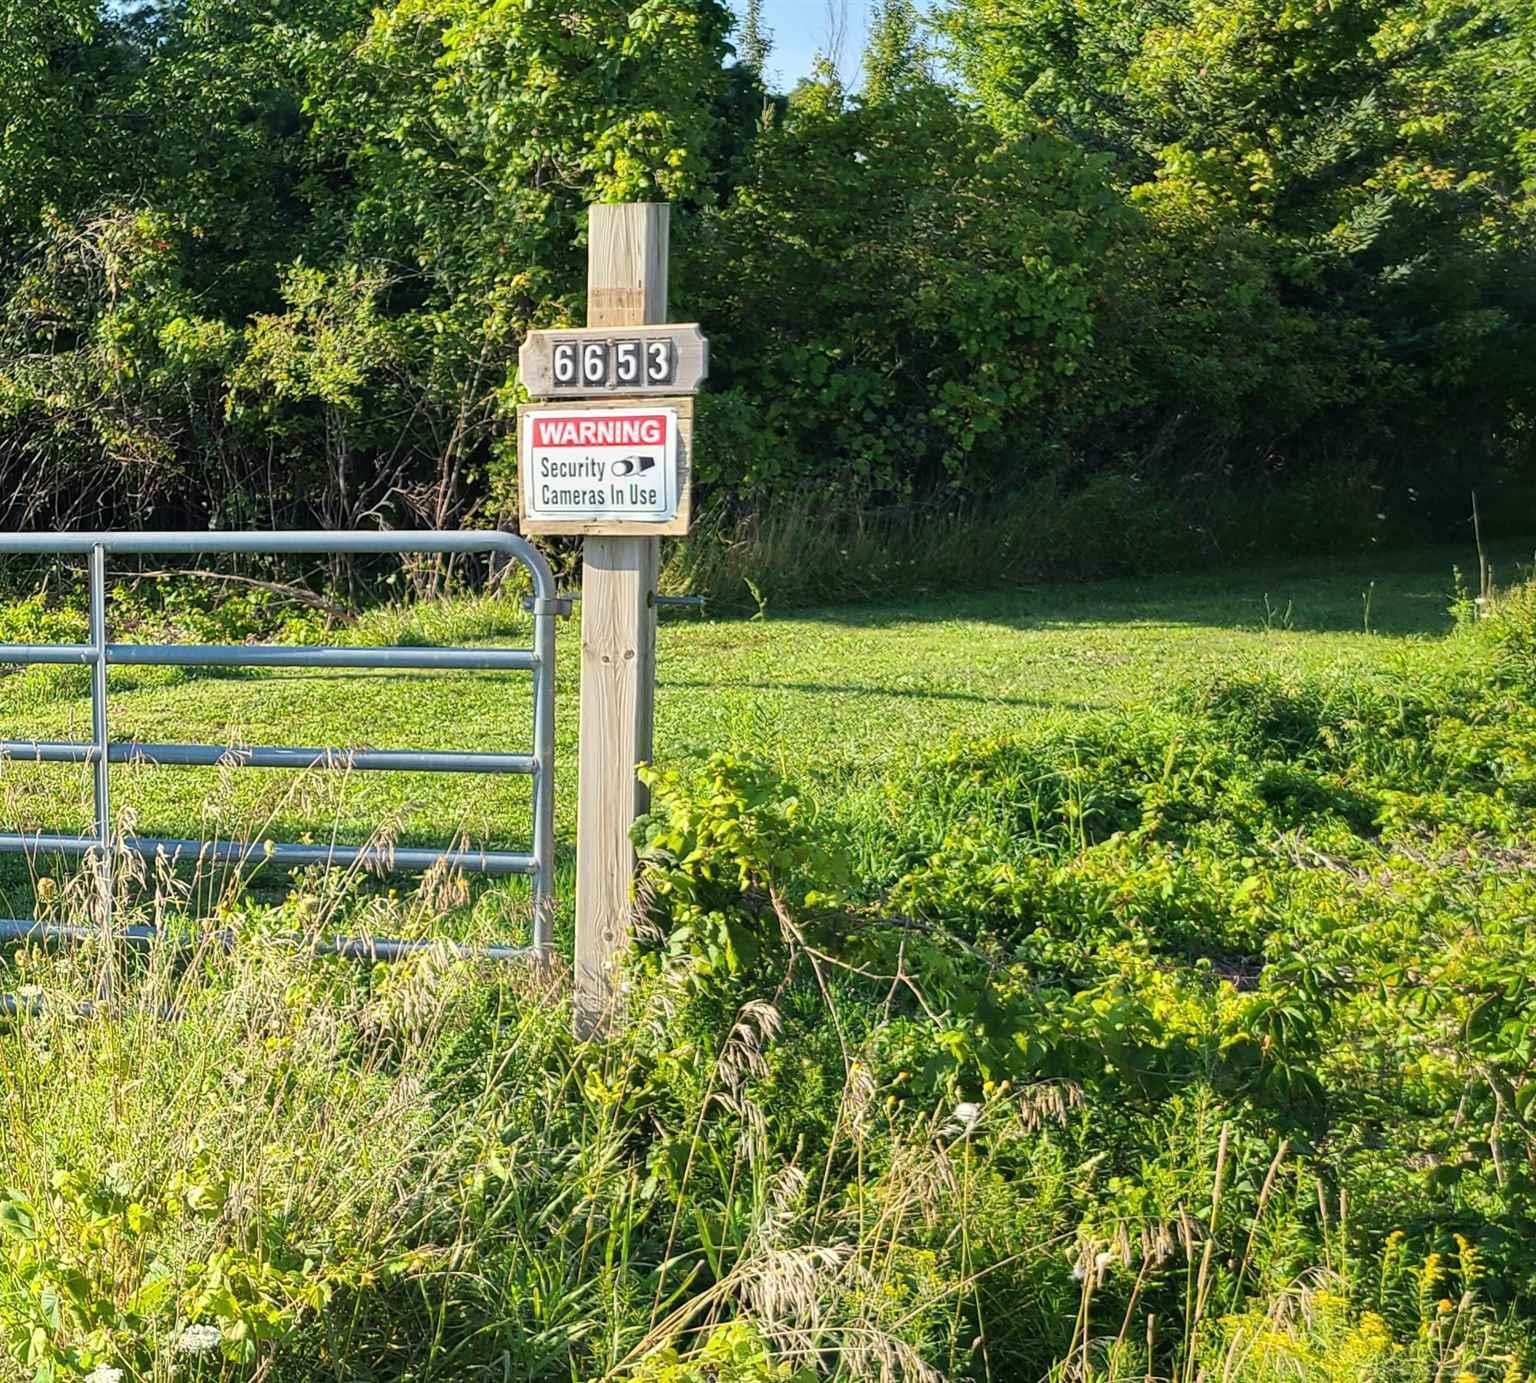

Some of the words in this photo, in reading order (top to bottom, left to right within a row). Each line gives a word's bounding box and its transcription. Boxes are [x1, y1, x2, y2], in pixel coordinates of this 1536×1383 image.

[554, 343, 669, 382] 6653
[539, 420, 660, 445] WARNING
[541, 457, 606, 482] Security
[542, 484, 605, 505] Cameras
[611, 484, 624, 505] In
[630, 483, 657, 505] Use
